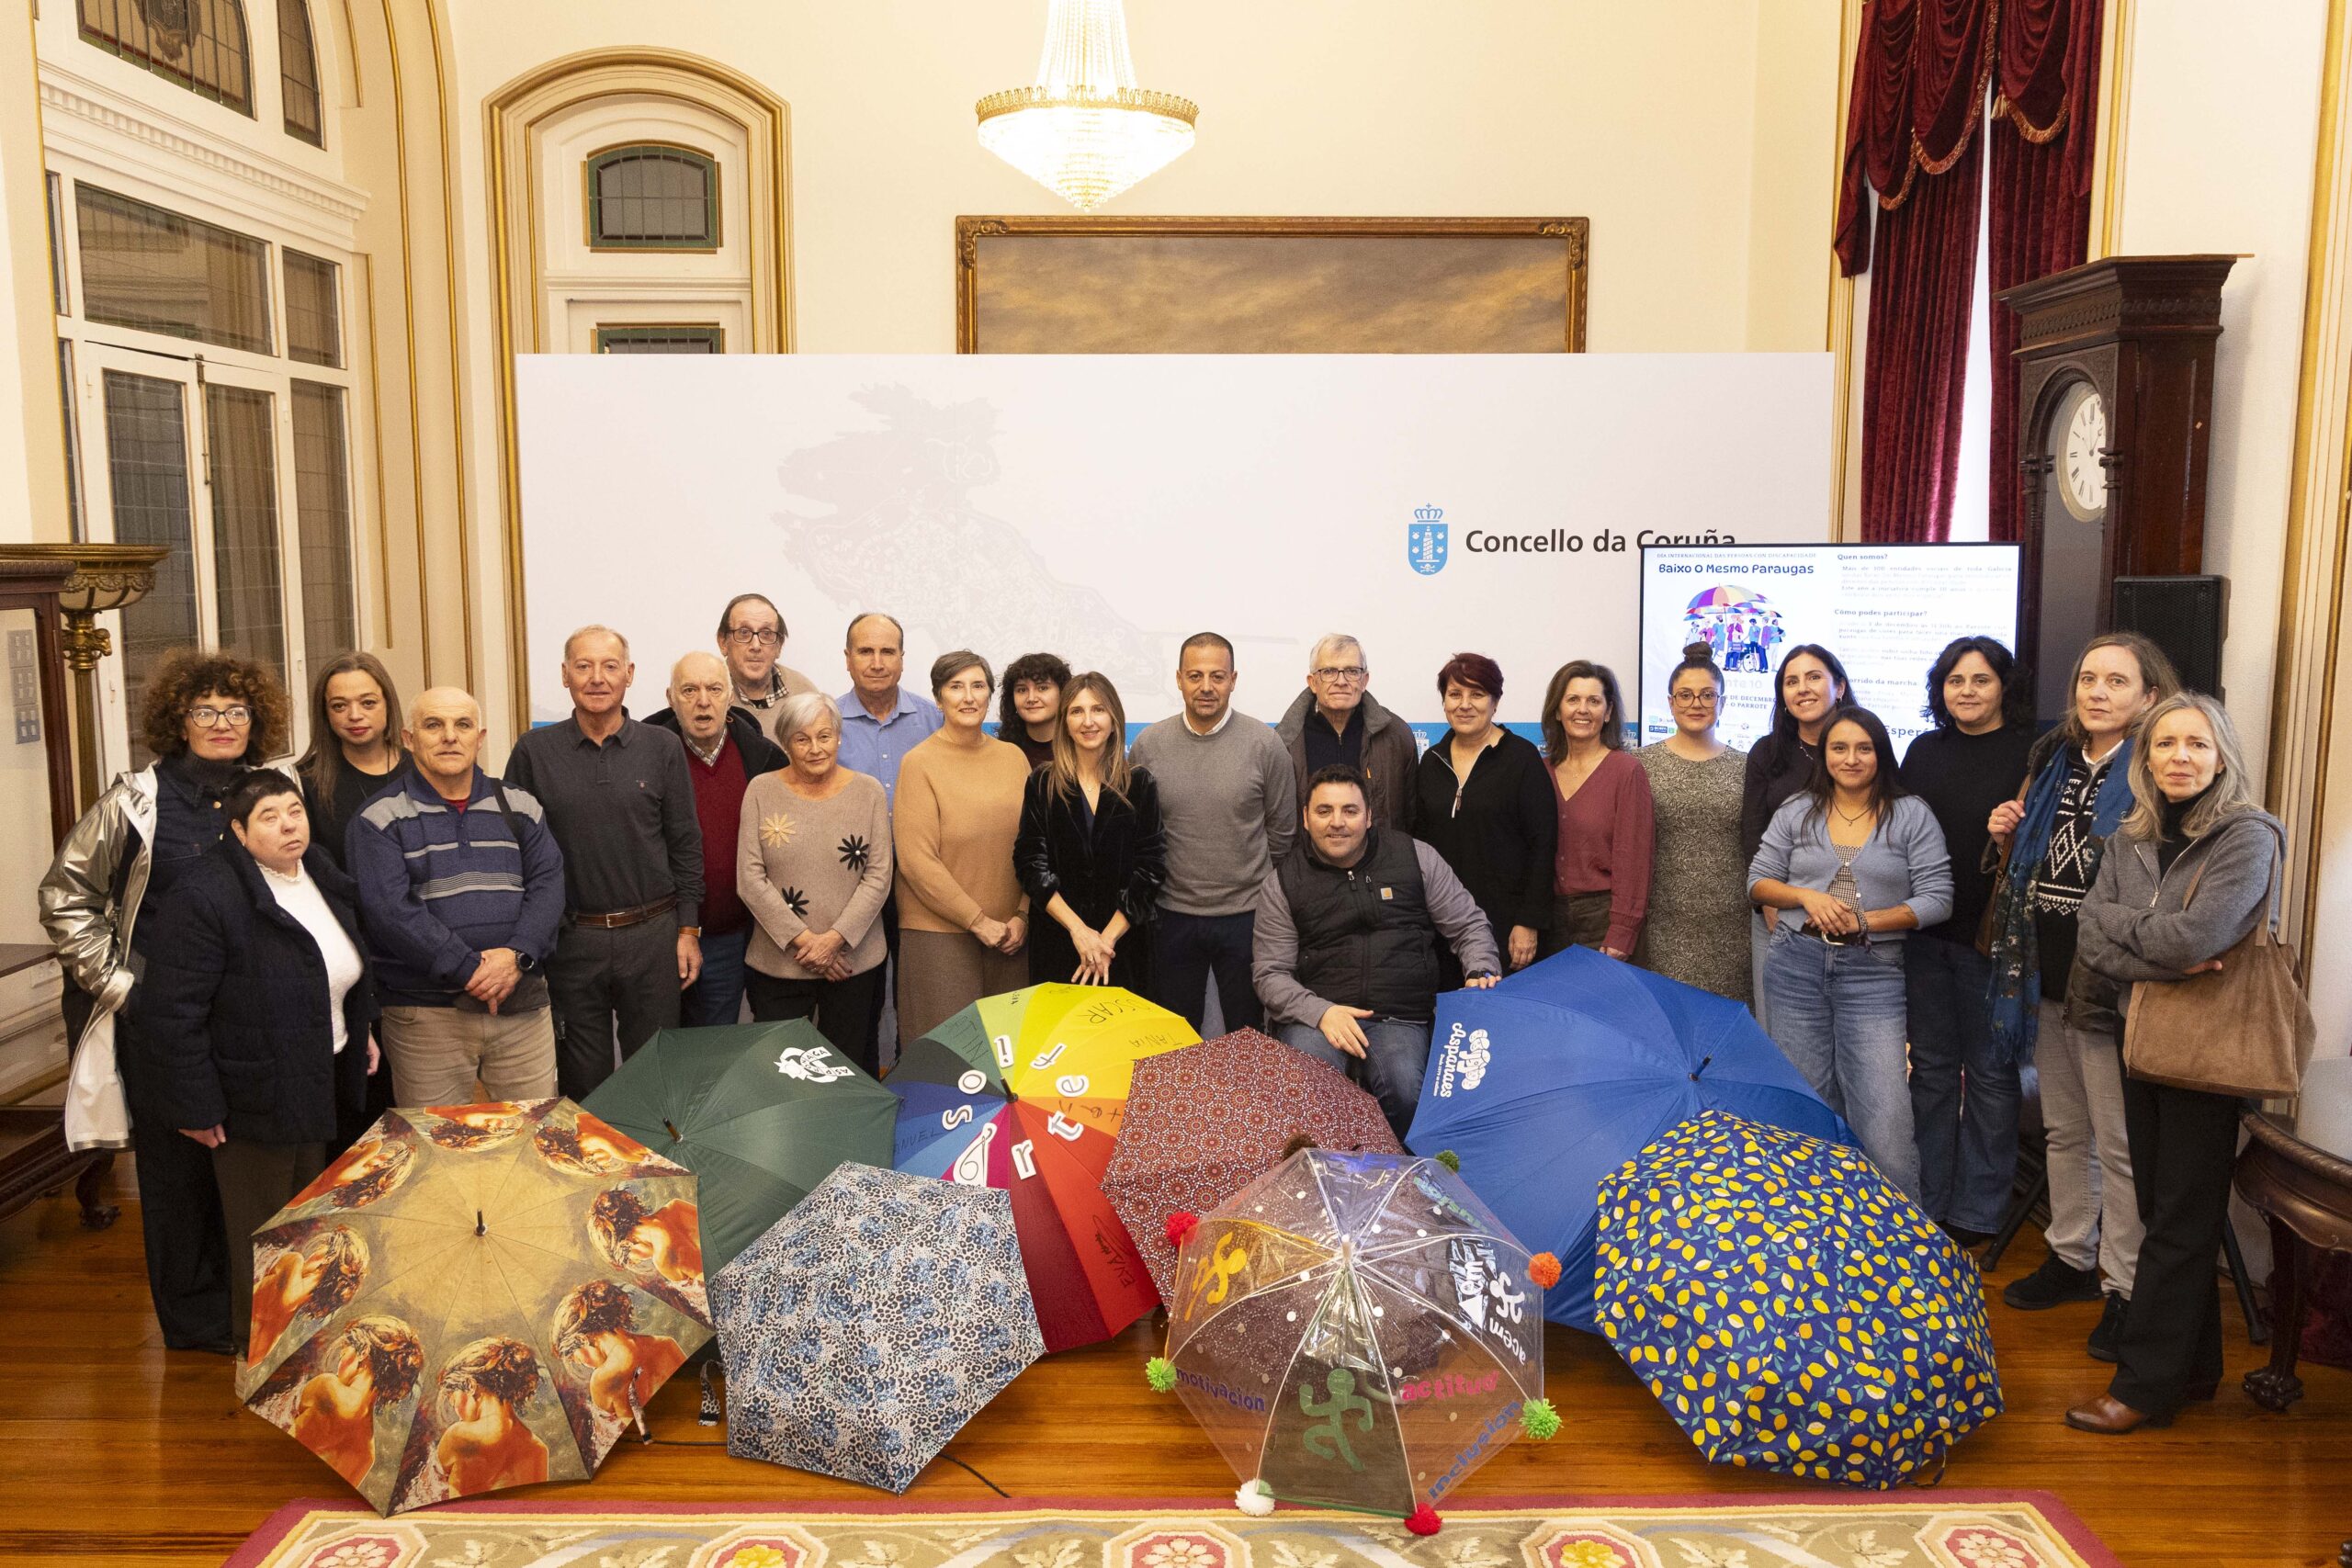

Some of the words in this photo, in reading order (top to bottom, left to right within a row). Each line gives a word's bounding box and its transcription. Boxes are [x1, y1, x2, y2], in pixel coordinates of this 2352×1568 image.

[1465, 528, 1583, 553] Concello
[1592, 528, 1626, 553] da
[1658, 563, 1692, 573] Baixo
[1694, 564, 1703, 573] O
[1706, 564, 1748, 573] Mesmo
[1752, 564, 1815, 576] Paraugas
[1883, 610, 1928, 618] participar?
[1440, 1022, 1467, 1099] Aspanaes
[1488, 1317, 1527, 1366] acem
[1175, 1366, 1266, 1412] motivacion
[1400, 1370, 1500, 1403] actitud
[1428, 1401, 1521, 1500] inclusion
